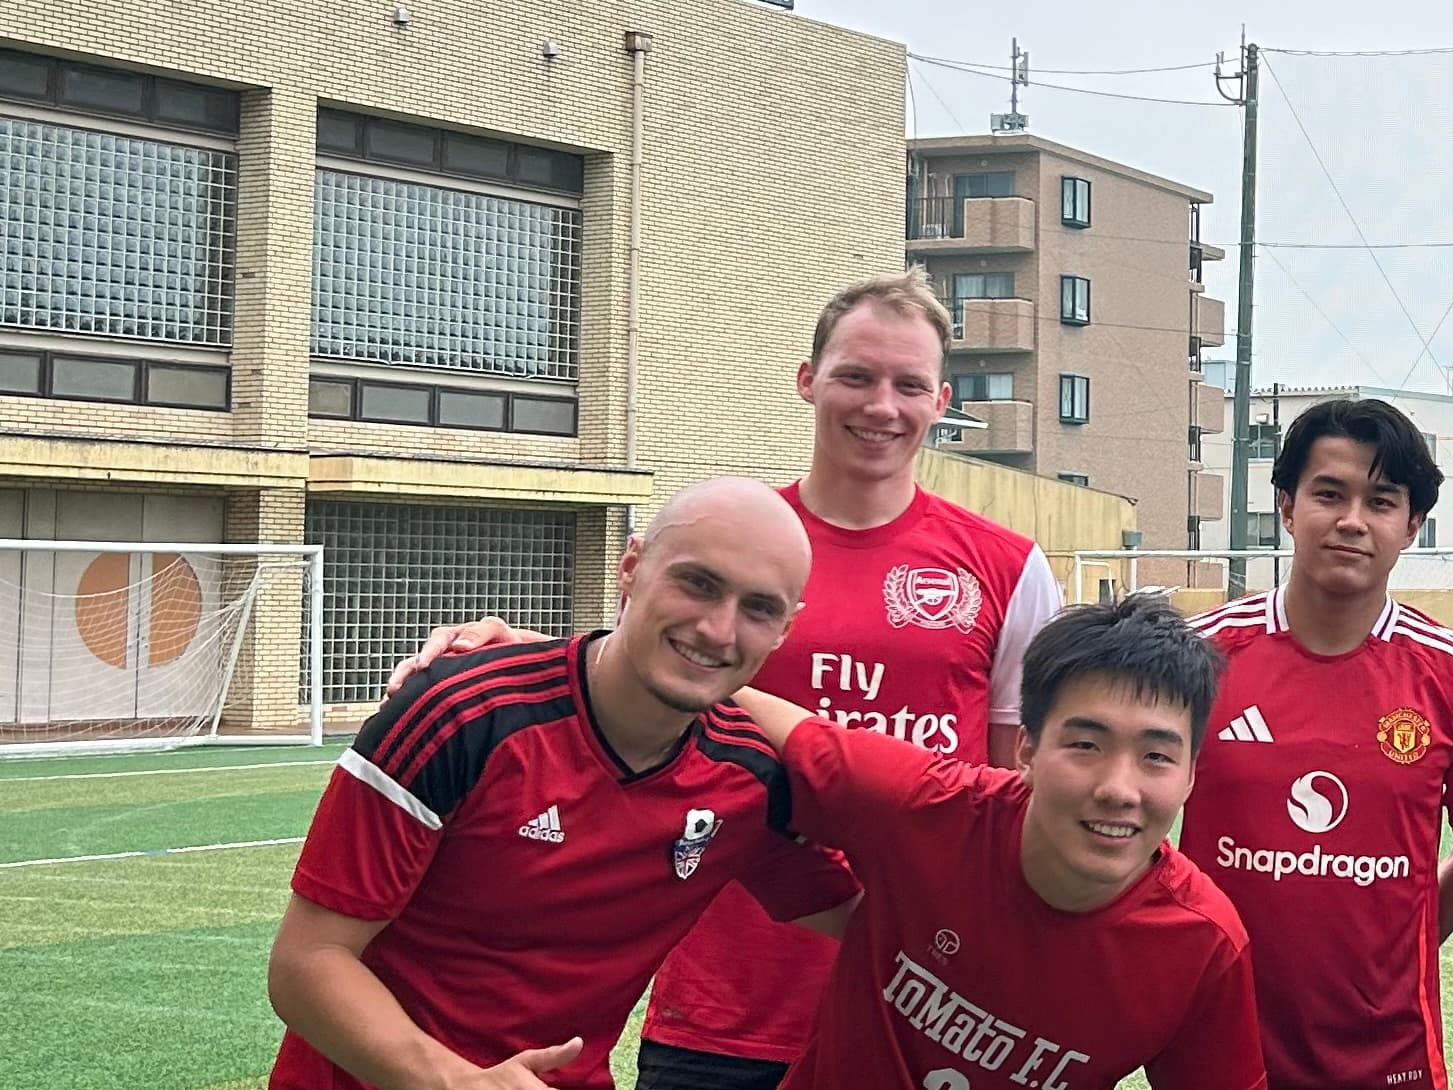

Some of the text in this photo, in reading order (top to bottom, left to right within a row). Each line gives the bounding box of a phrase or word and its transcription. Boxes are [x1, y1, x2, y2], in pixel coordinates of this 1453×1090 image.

[811, 652, 885, 701] Fly
[519, 826, 565, 842] adidas
[1216, 836, 1409, 886] Snapdragon
